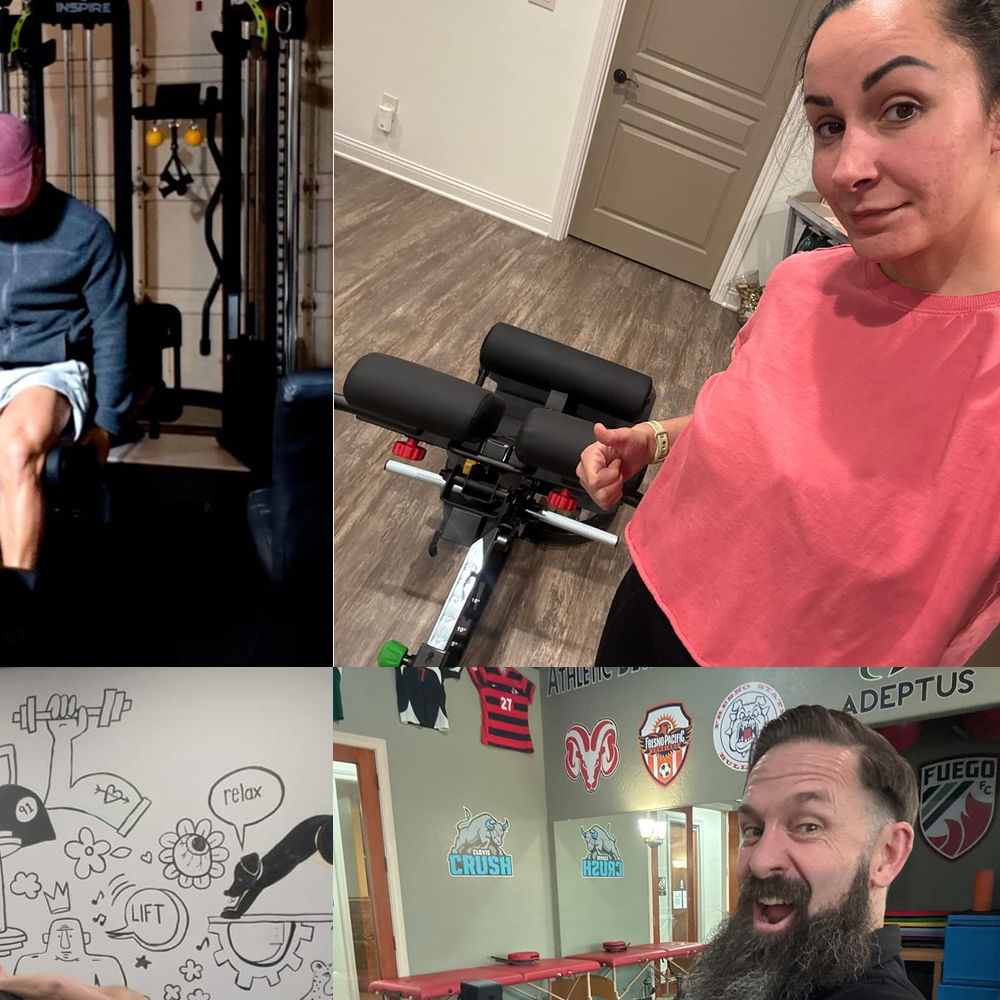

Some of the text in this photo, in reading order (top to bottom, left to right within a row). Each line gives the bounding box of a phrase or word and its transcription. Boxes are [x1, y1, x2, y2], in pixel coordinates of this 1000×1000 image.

[56, 2, 111, 13] INSPIRE
[841, 668, 976, 715] ADEPTUS
[500, 696, 513, 713] 27
[645, 736, 665, 750] FRESNO
[665, 729, 686, 746] PACIFIC
[719, 752, 749, 771] BULL
[924, 759, 996, 786] FUEGO
[223, 783, 262, 806] relax
[979, 781, 992, 795] FC
[19, 802, 34, 815] 91
[449, 854, 512, 875] CRUSH
[132, 903, 165, 925] LIFT
